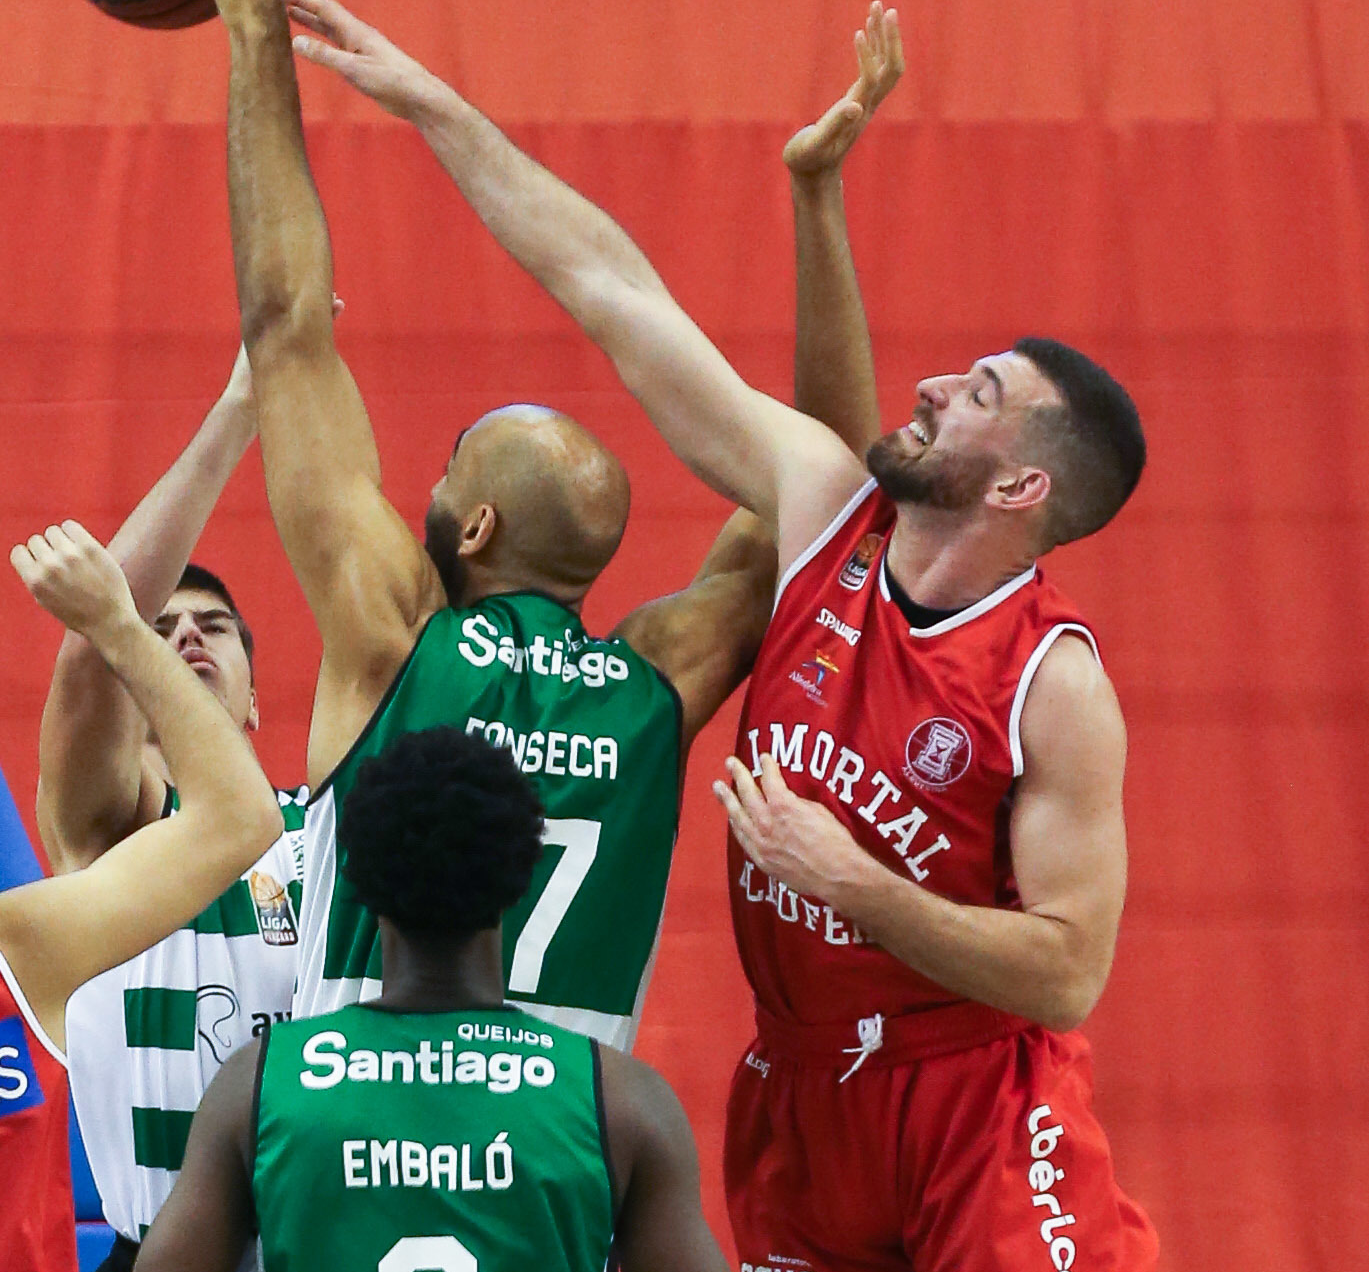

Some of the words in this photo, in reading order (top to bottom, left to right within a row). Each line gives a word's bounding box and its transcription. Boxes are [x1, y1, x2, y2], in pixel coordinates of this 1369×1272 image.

[748, 722, 951, 881] IMORTAL
[260, 915, 292, 931] LIGA
[300, 1031, 557, 1093] Santiago
[457, 1023, 555, 1050] QUEIJOS
[343, 1132, 515, 1192] EMBALÓ
